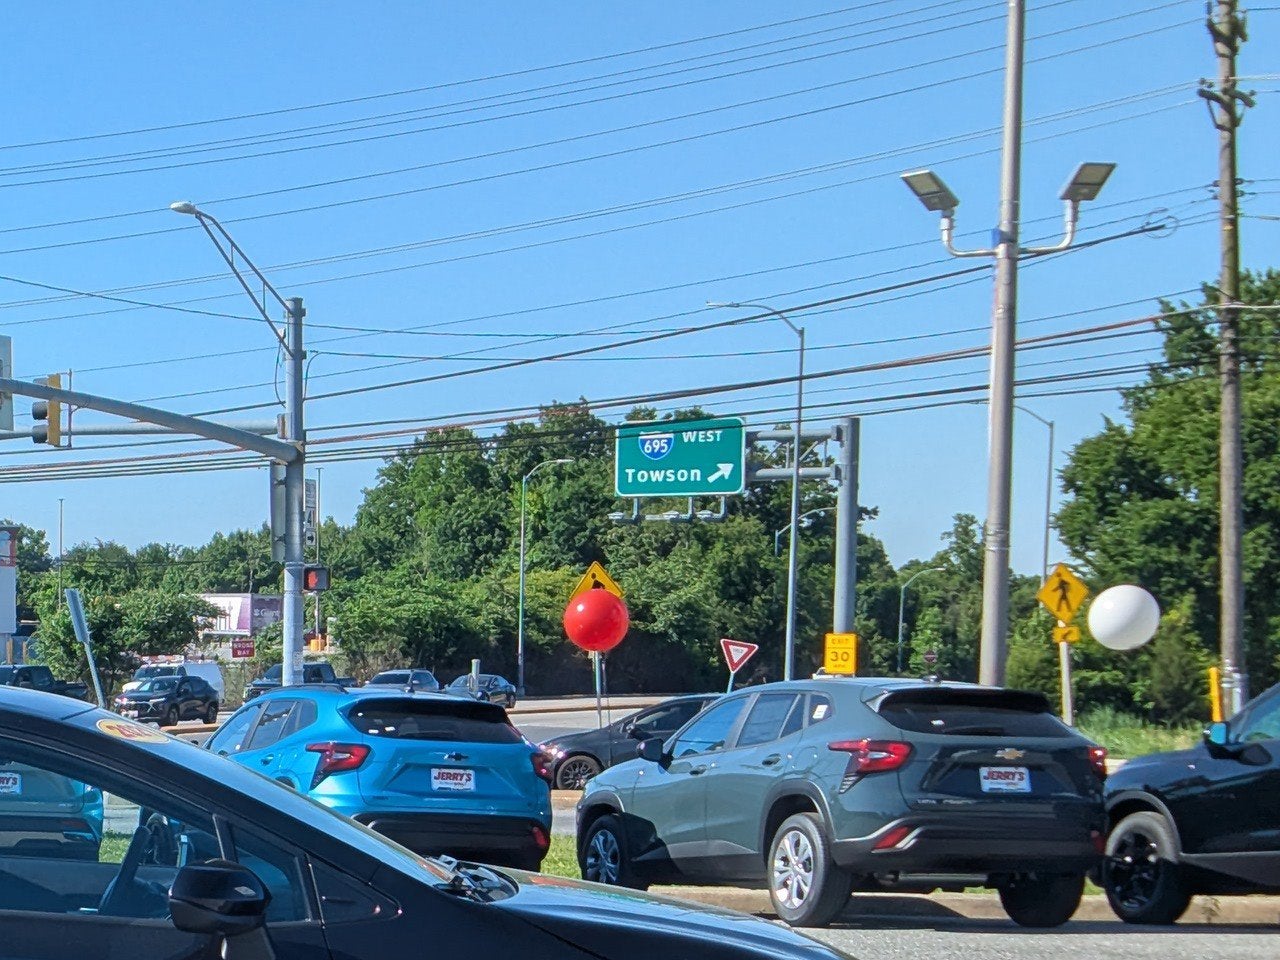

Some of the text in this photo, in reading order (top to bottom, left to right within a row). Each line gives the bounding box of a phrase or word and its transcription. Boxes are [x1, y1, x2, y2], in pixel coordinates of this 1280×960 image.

[681, 430, 723, 443] WEST
[644, 439, 669, 454] 695
[624, 468, 701, 483] Towson
[830, 651, 850, 662] 30
[433, 771, 472, 783] JERRY'S
[982, 770, 1025, 782] JERRY'S
